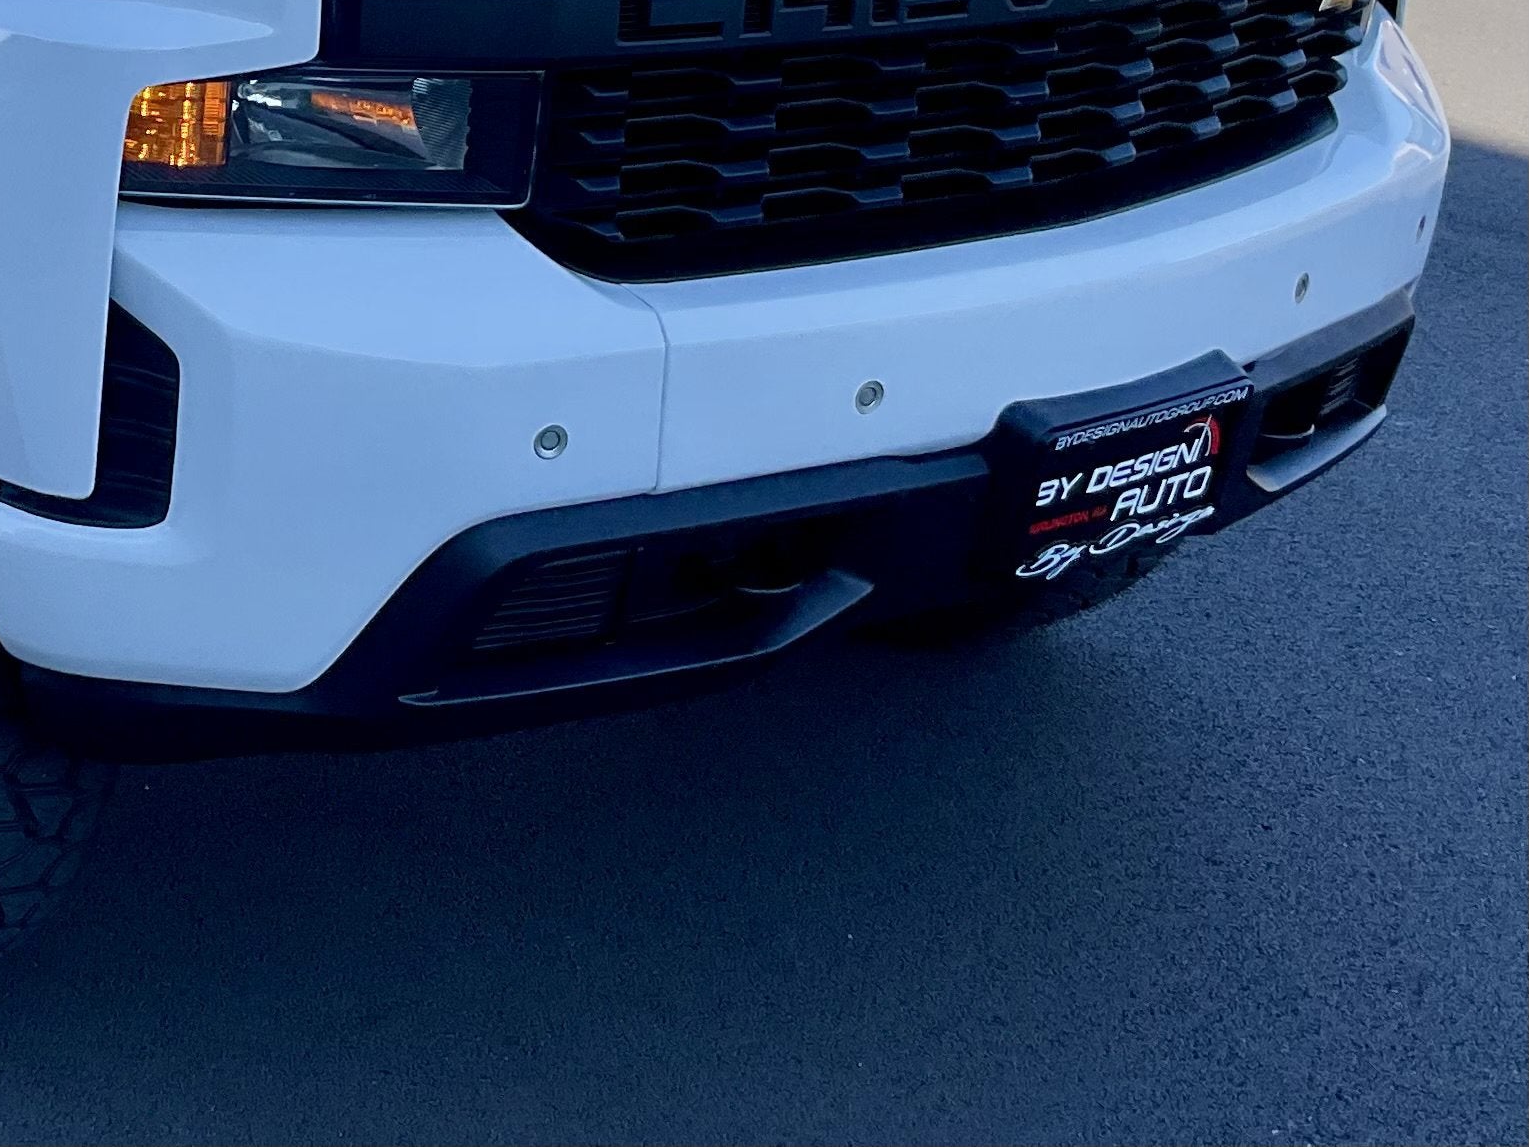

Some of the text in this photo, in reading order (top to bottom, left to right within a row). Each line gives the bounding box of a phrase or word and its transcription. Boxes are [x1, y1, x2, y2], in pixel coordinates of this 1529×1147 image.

[1035, 438, 1201, 507] BY DESIGN
[1109, 465, 1213, 522] AUTO
